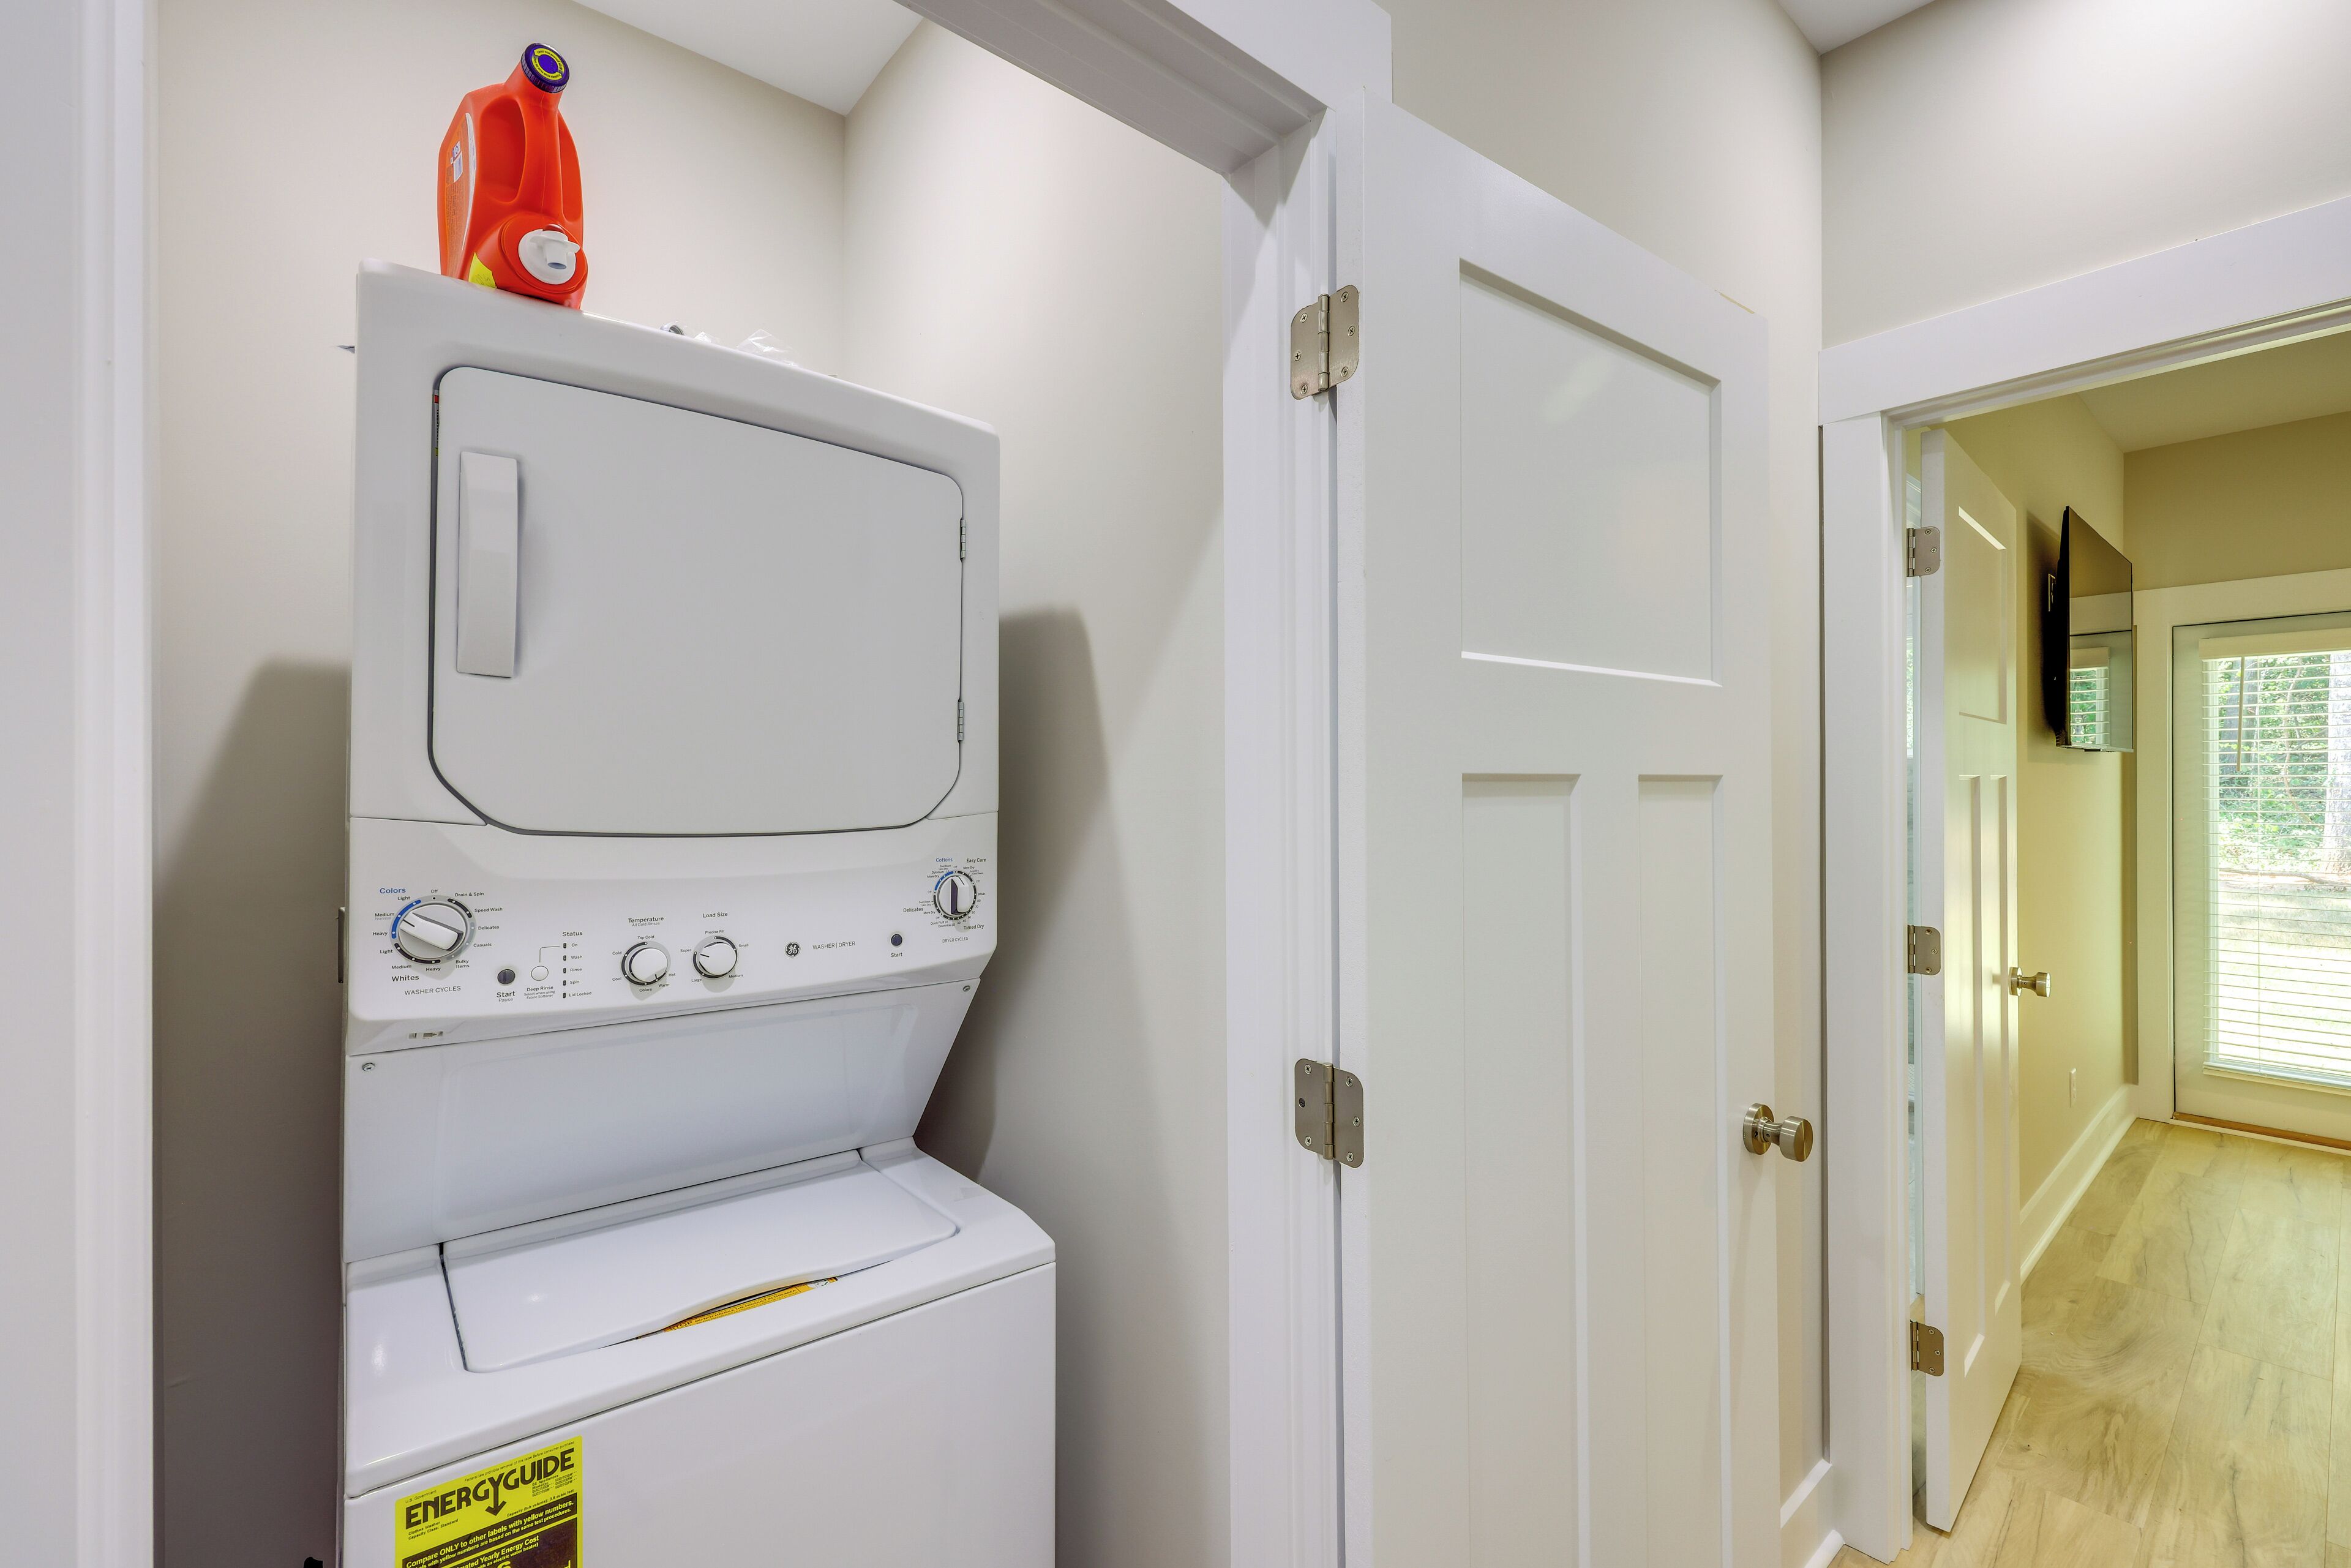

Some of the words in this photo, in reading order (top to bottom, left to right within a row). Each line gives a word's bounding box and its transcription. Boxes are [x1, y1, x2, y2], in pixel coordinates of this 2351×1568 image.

[786, 943, 799, 956] GE
[744, 1299, 767, 1308] PRODUCT
[405, 1447, 574, 1529] ENERGYGUIDE
[538, 1474, 559, 1484] Appliances
[414, 1490, 437, 1500] Government
[507, 1509, 523, 1517] Capacity
[406, 1553, 438, 1568] Compare
[440, 1542, 459, 1556] ONLY
[469, 1533, 487, 1545] other
[487, 1525, 508, 1537] labels
[508, 1519, 522, 1529] with
[523, 1511, 544, 1525] yellow
[545, 1500, 574, 1515] numbers.
[408, 1531, 426, 1540] Capacity
[440, 1518, 459, 1528] Standard
[440, 1553, 456, 1564] yellow
[457, 1544, 479, 1555] numbers
[489, 1533, 504, 1543] based
[544, 1507, 571, 1523] procedures.
[479, 1551, 500, 1564] Yearly
[501, 1542, 523, 1555] Energy
[524, 1535, 539, 1545] Cost
[493, 1554, 509, 1564] electric
[523, 1542, 539, 1551] heater)
